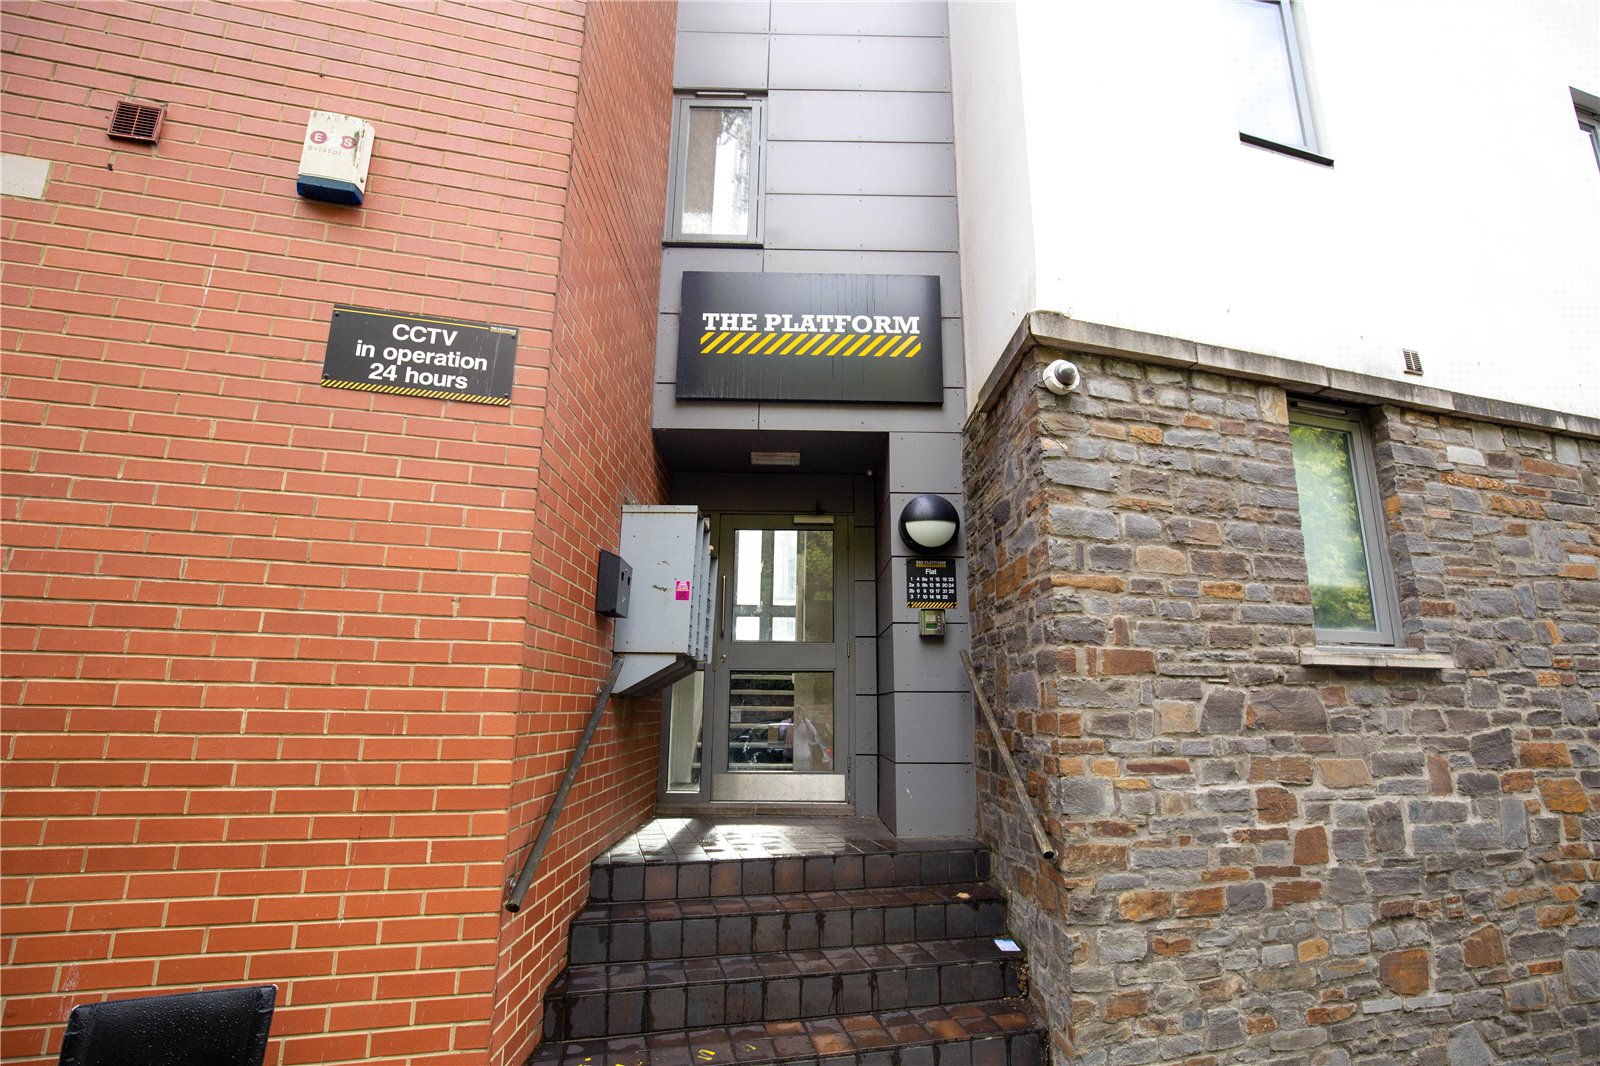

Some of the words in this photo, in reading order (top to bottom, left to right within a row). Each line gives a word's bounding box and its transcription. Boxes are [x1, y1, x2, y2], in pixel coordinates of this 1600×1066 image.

[308, 146, 342, 156] Bristol
[392, 323, 459, 346] CCTV
[702, 312, 758, 332] THE
[763, 313, 921, 334] PLATFORM
[355, 340, 376, 358] in
[382, 346, 488, 371] operation
[368, 362, 398, 382] 24
[404, 366, 468, 390] hours
